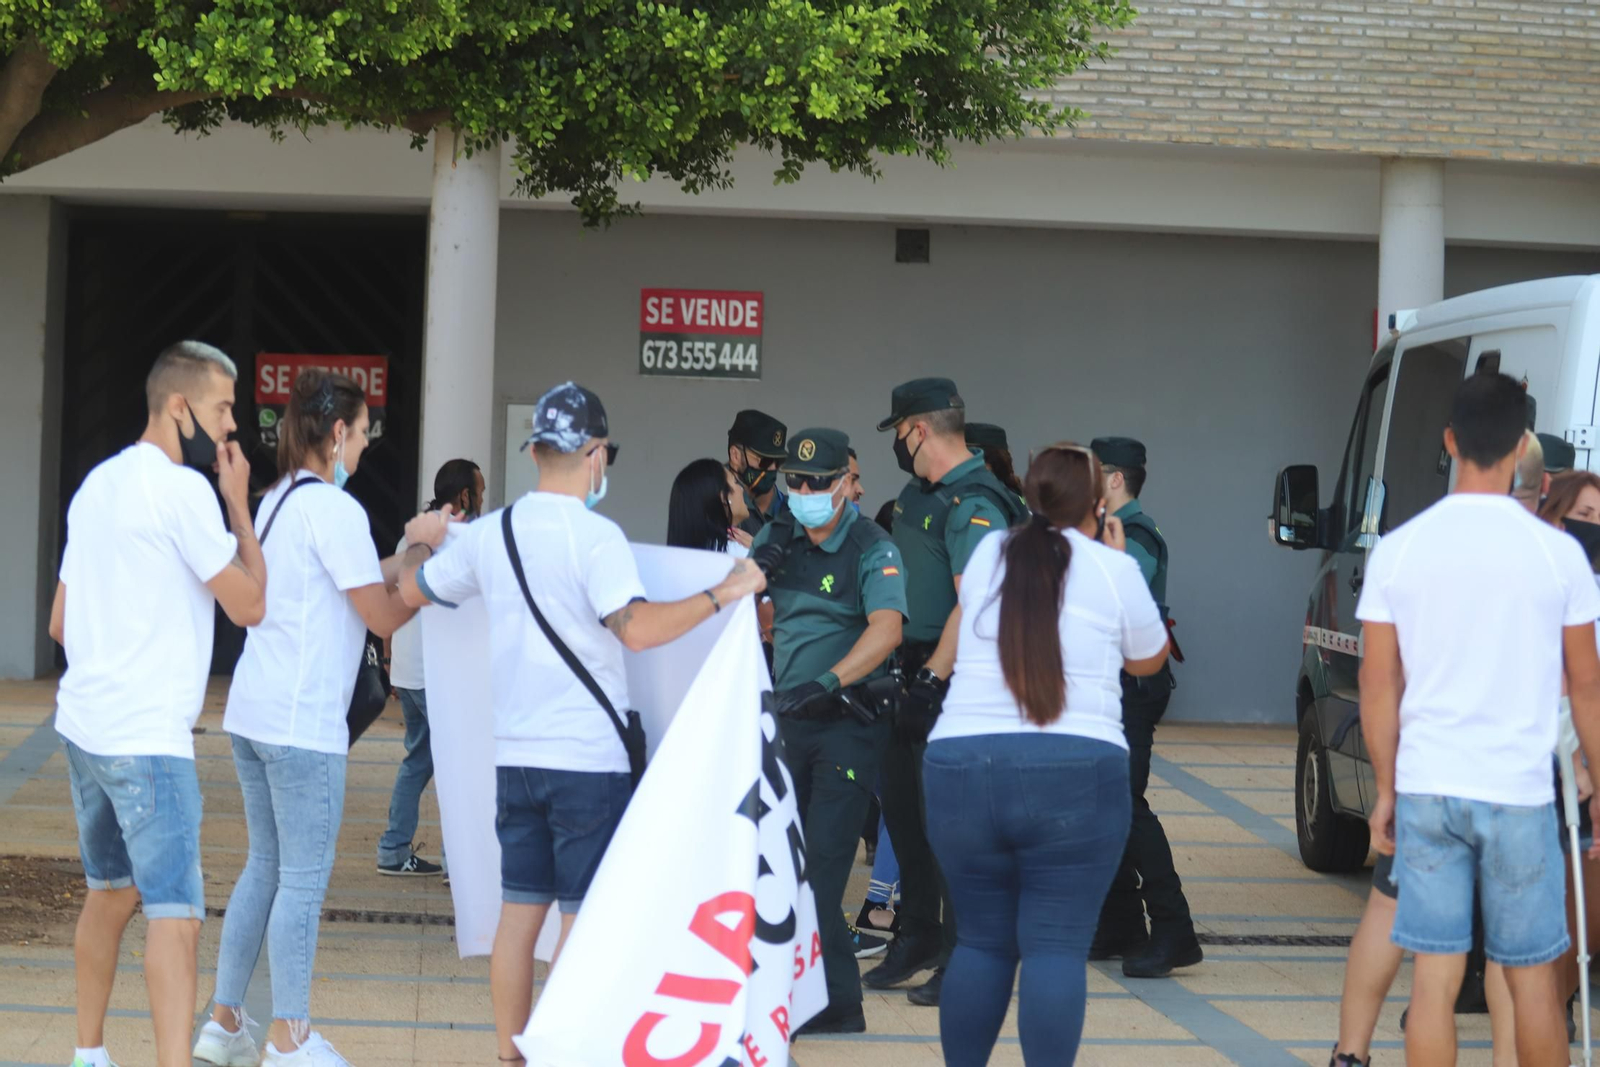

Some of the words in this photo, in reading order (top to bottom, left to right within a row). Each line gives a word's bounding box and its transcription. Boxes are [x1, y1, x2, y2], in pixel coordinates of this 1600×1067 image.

[645, 296, 674, 325] SE
[680, 298, 759, 328] VENDE
[260, 364, 291, 394] SE
